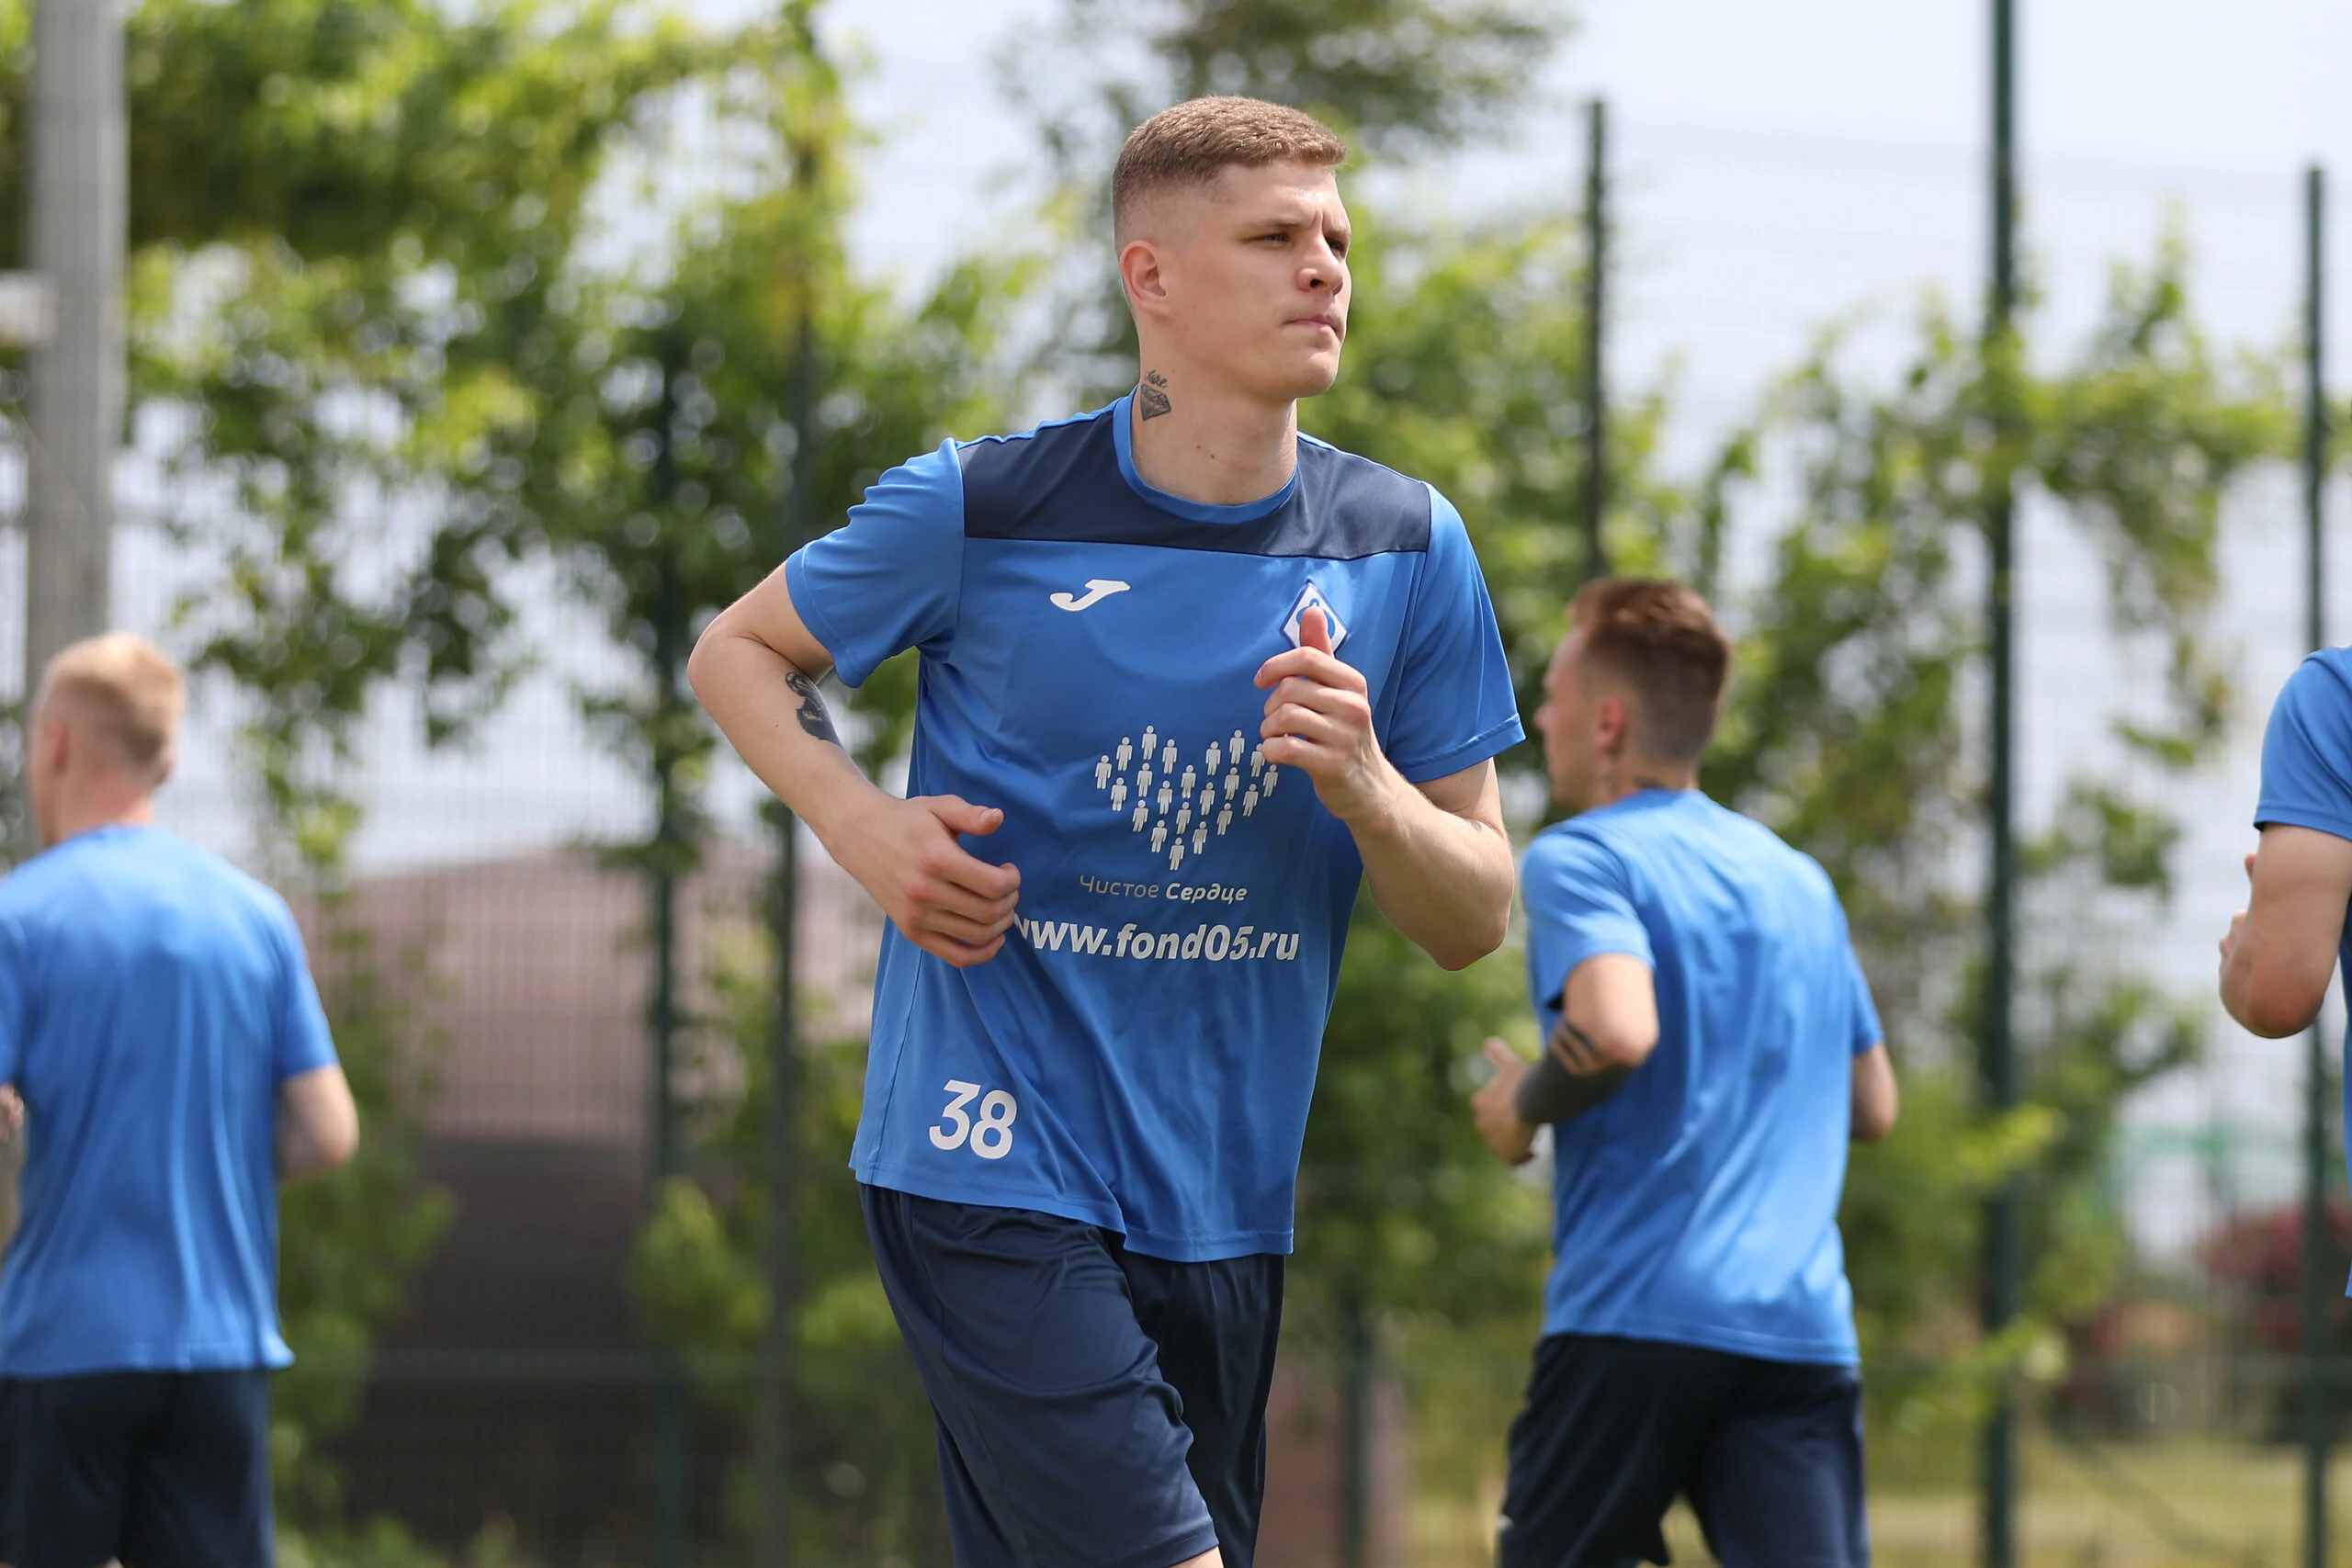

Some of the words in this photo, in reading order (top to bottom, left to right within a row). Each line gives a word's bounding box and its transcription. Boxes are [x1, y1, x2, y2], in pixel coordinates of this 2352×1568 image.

[1080, 874, 1159, 898] Чистое
[1165, 882, 1248, 905] Сердце
[929, 1079, 1018, 1159] 38
